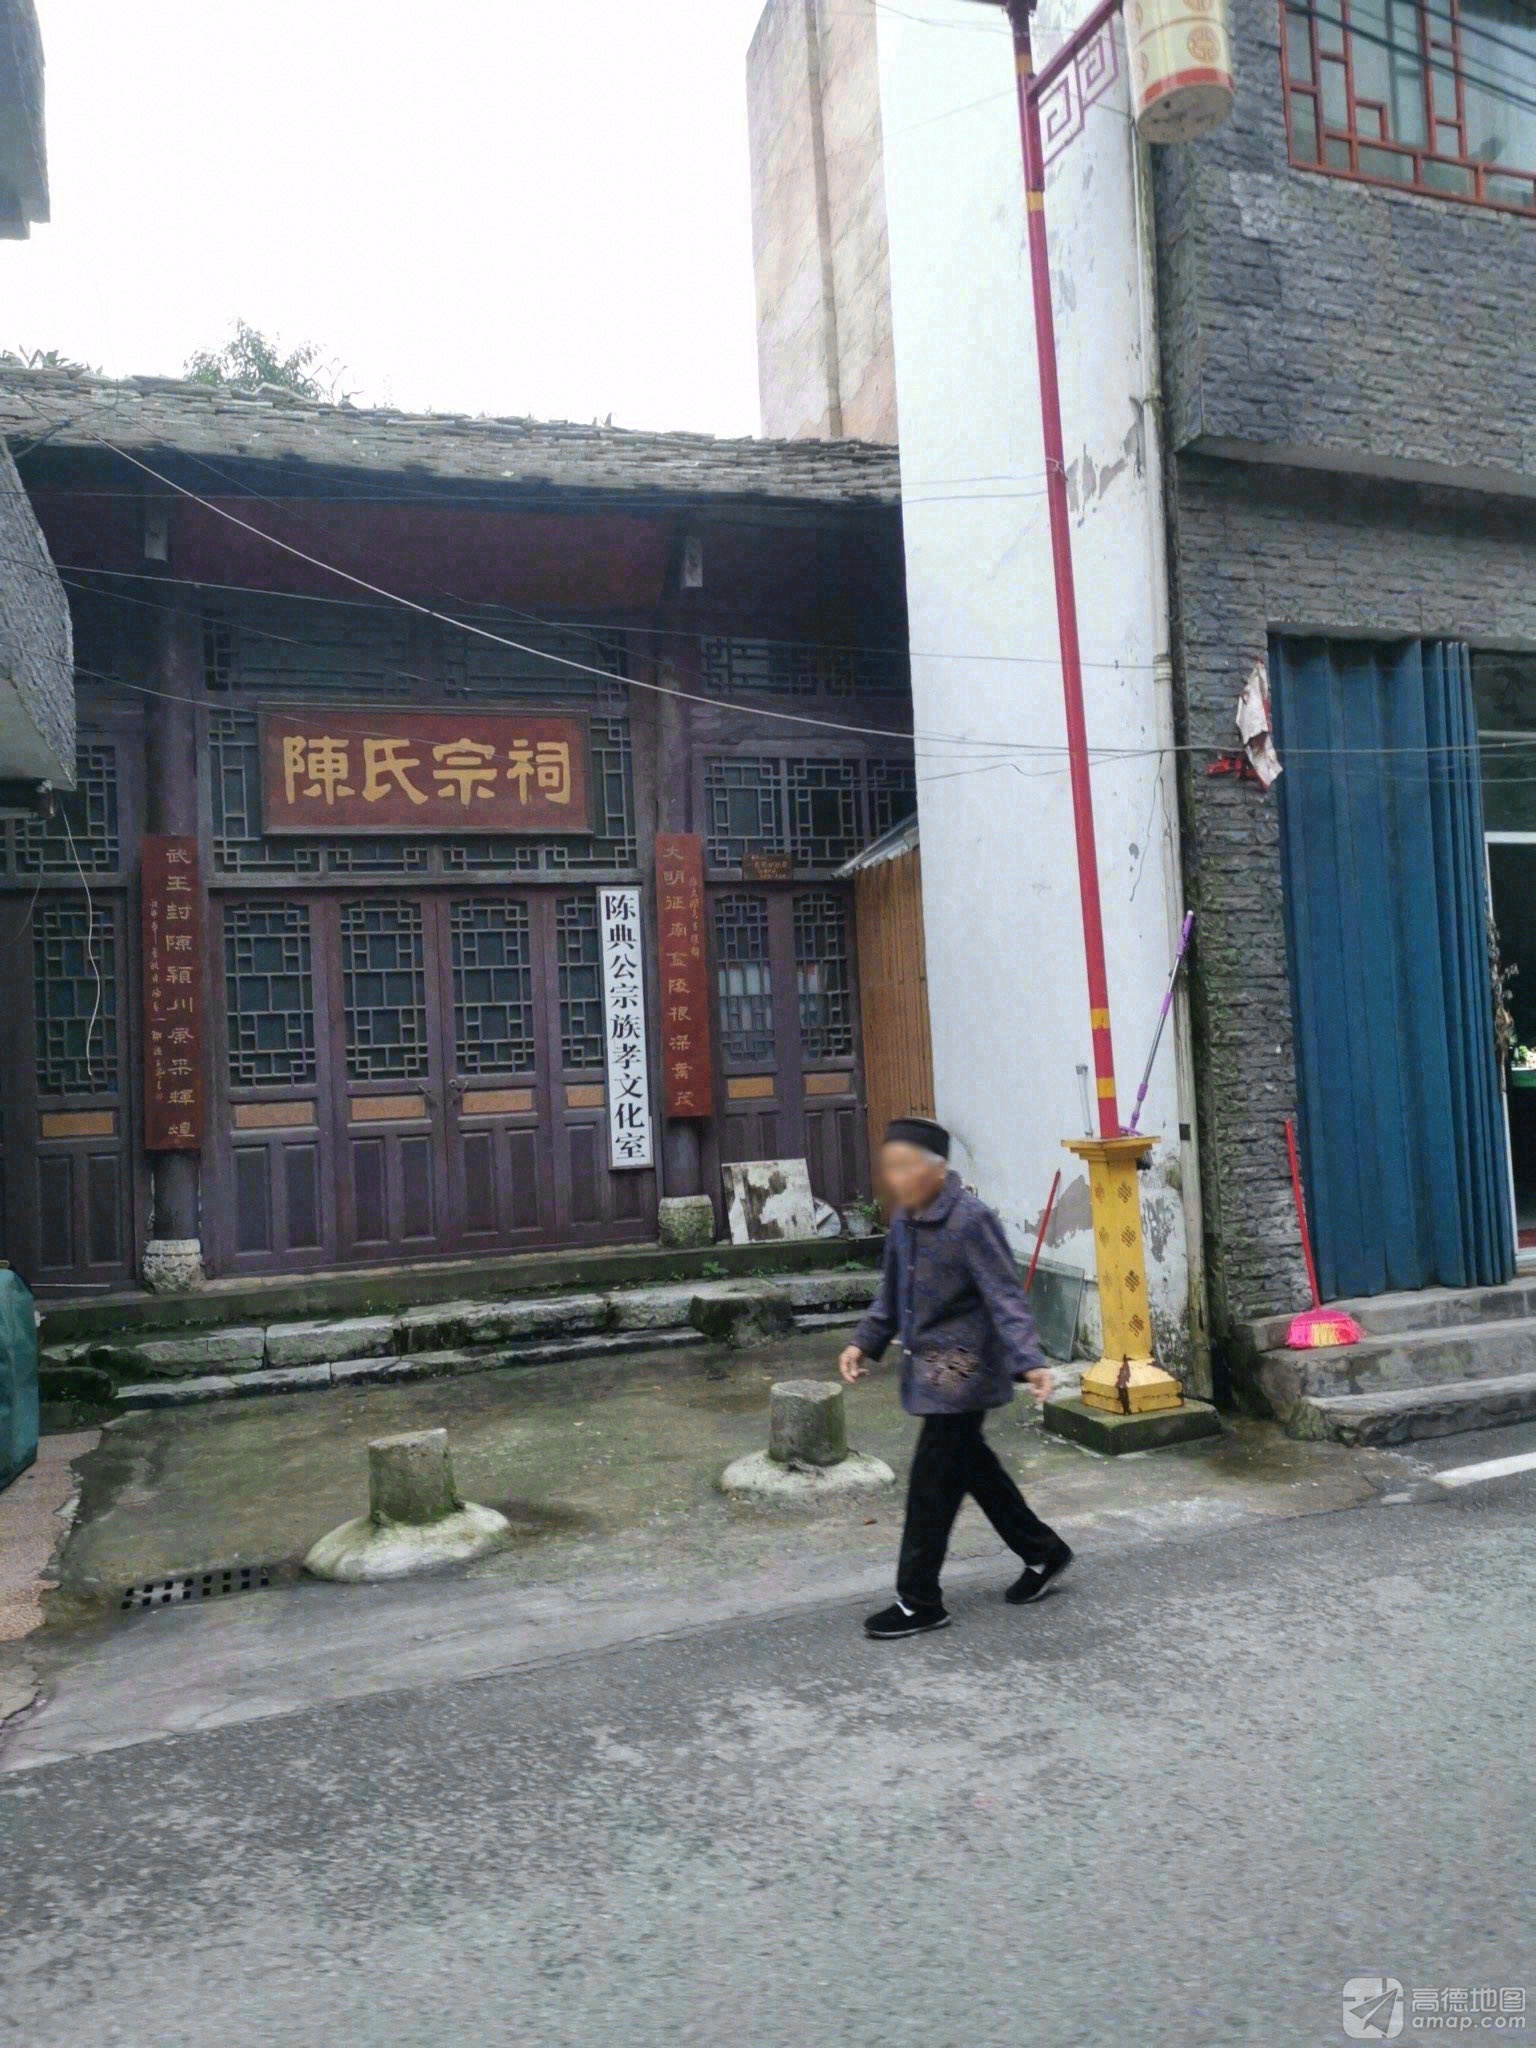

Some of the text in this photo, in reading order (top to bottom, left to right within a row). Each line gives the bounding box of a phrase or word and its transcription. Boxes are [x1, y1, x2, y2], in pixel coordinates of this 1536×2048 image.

[282, 735, 571, 805] 陳氏宗祠
[605, 893, 646, 1160] 陈典公宗族孝文化室
